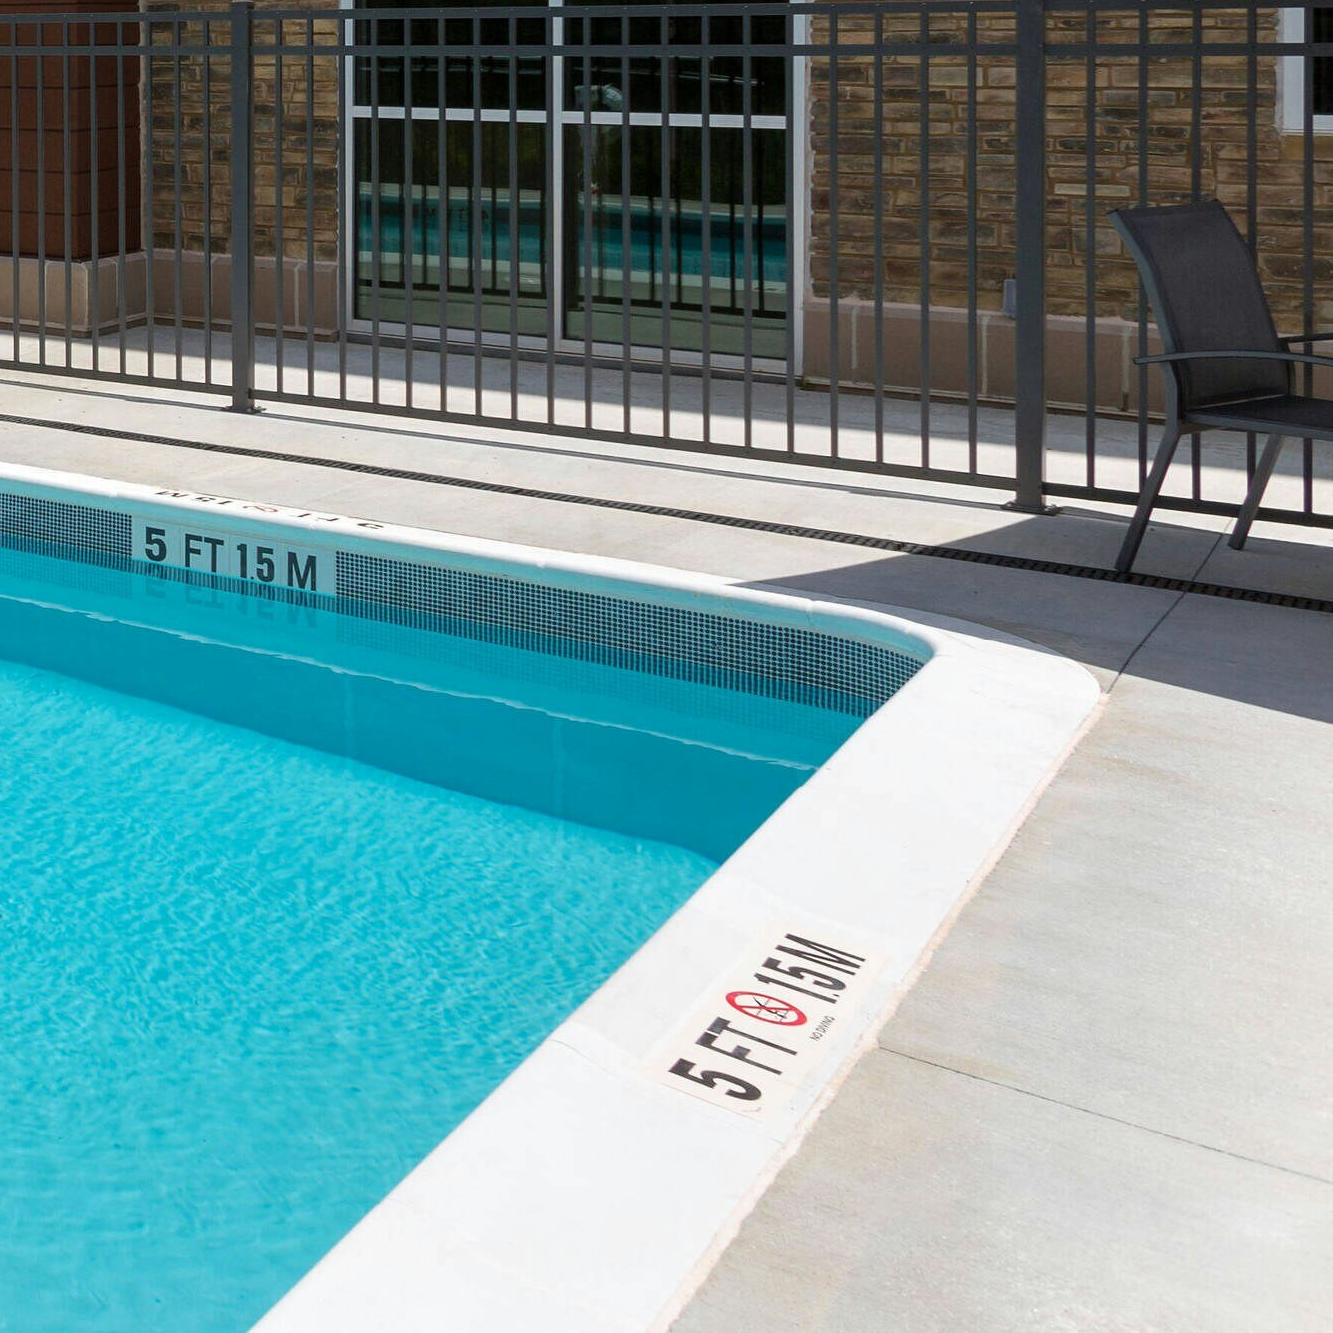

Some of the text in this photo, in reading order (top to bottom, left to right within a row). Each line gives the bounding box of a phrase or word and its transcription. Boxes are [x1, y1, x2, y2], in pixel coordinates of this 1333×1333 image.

[145, 526, 166, 562] 5
[185, 533, 224, 572] FT
[695, 1016, 798, 1075] FT
[668, 1058, 762, 1100] 5
